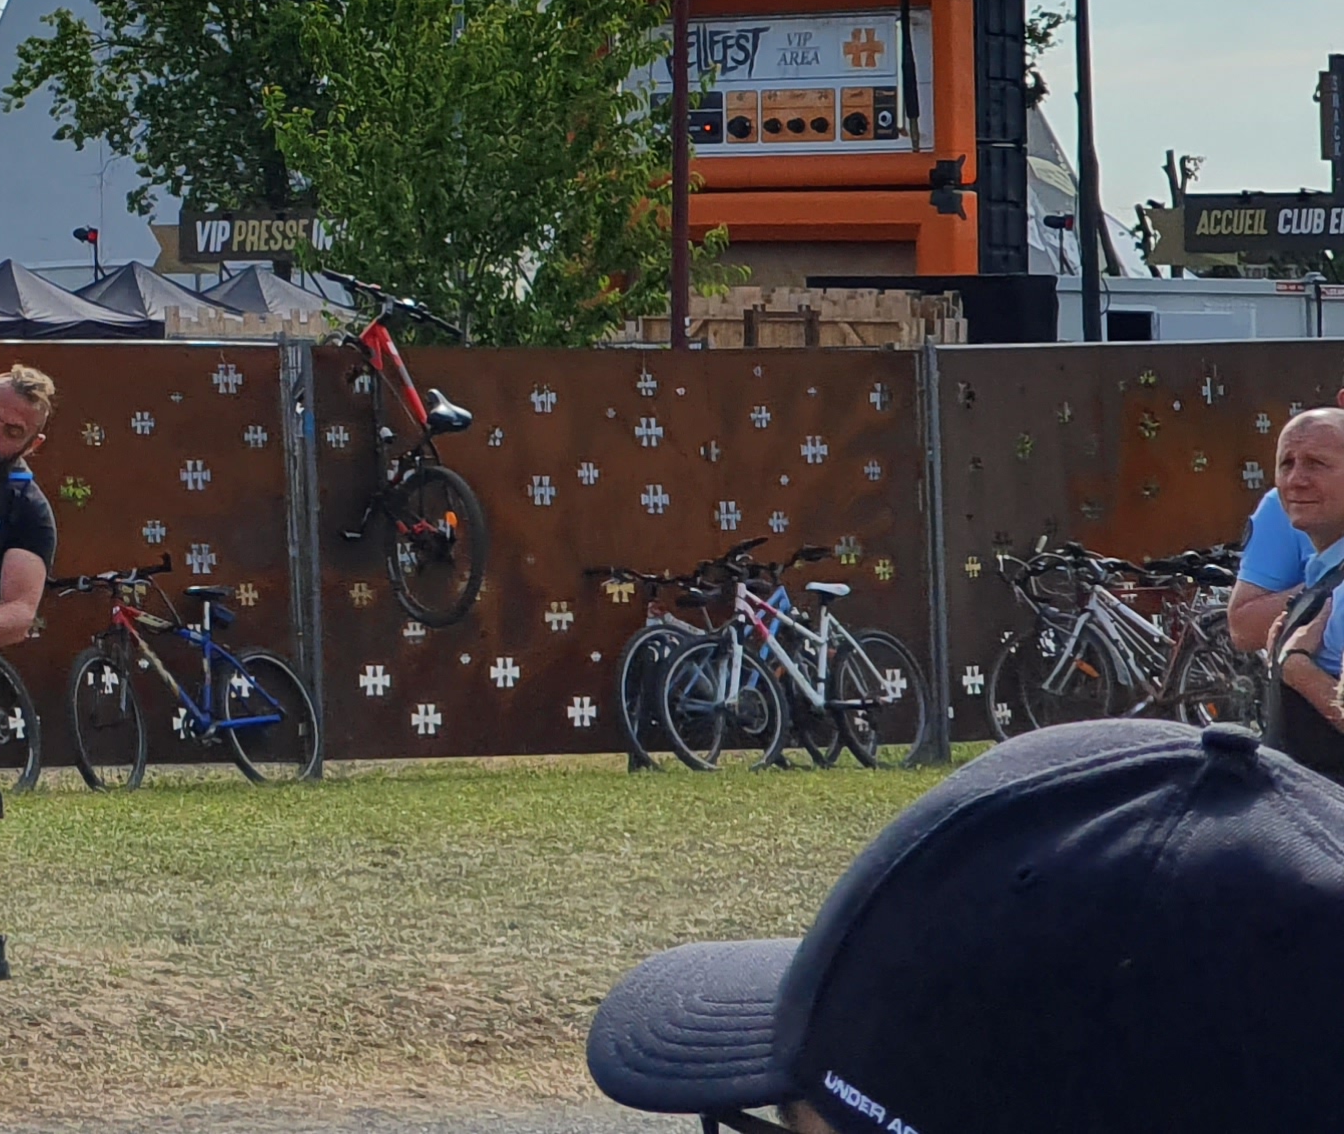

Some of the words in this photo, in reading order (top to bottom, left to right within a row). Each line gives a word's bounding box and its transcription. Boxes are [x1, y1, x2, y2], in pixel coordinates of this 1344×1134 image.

[786, 31, 813, 48] VIP
[777, 50, 820, 66] AREA
[1196, 209, 1268, 235] ACCUEIL
[1277, 208, 1325, 235] CLUB
[196, 220, 230, 252] VIP
[824, 1070, 886, 1124] UNDER
